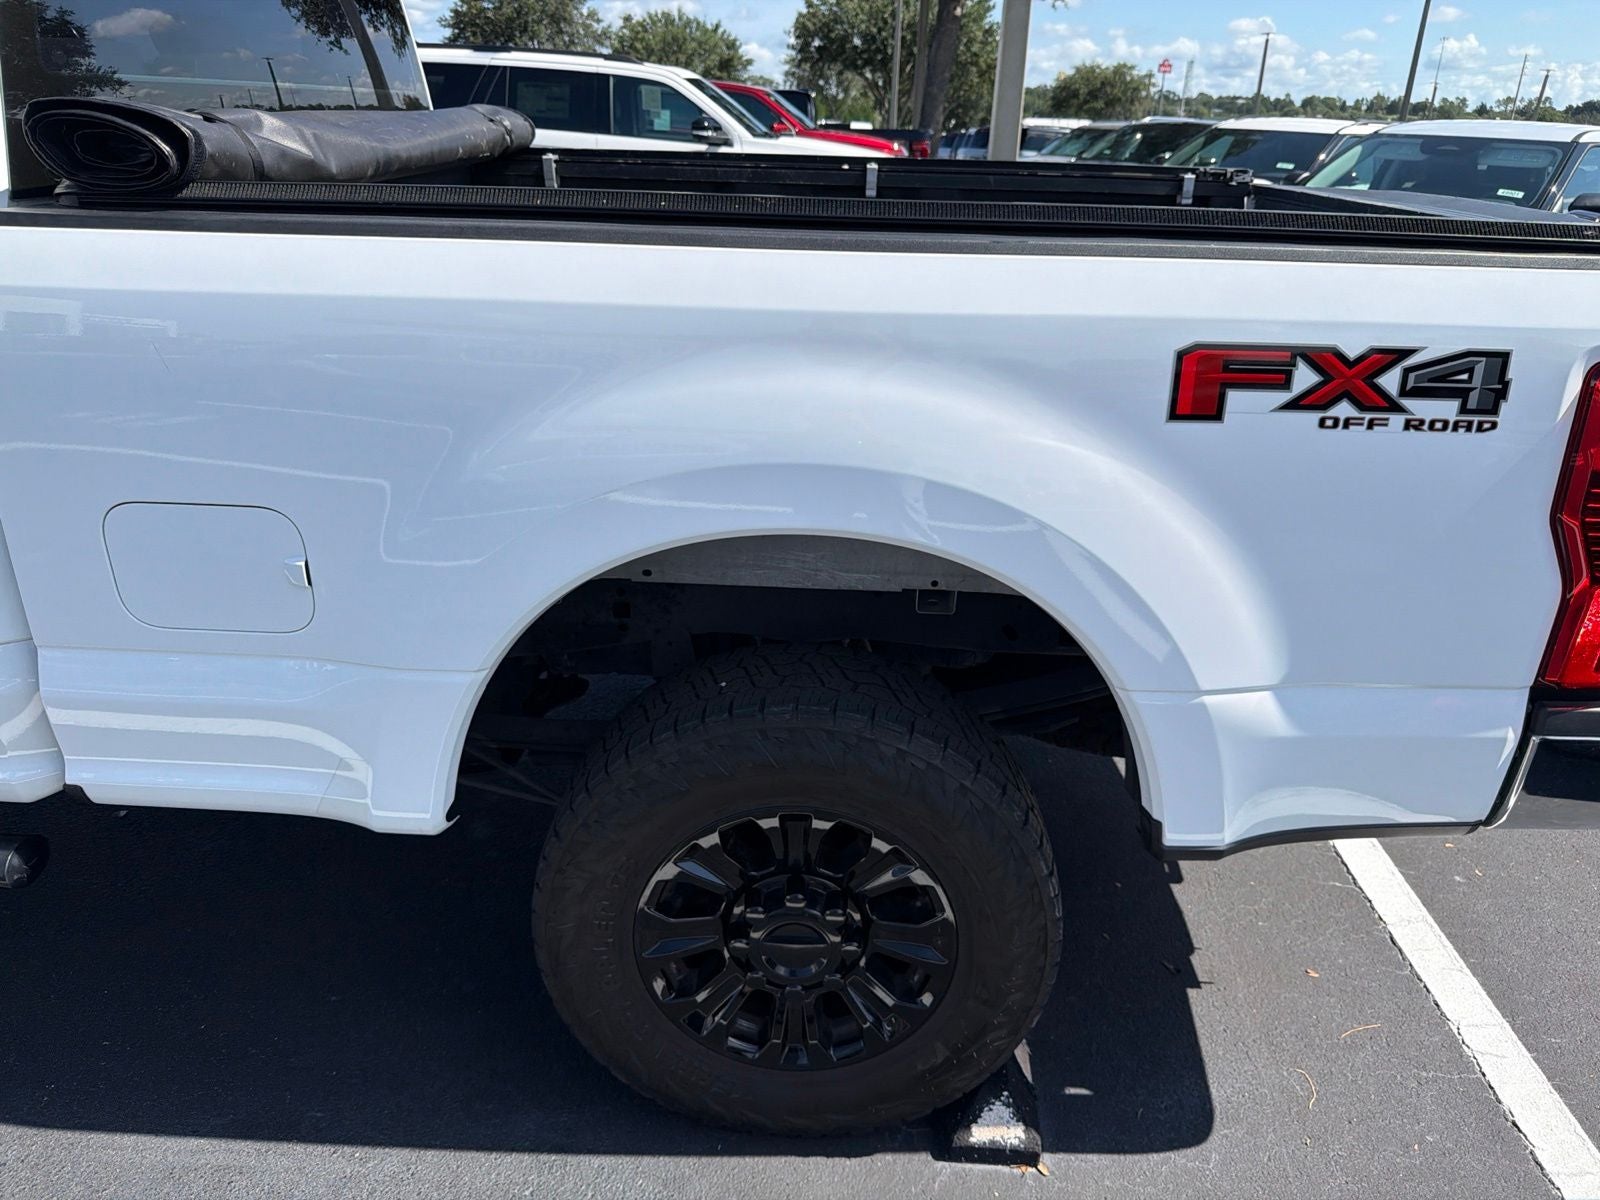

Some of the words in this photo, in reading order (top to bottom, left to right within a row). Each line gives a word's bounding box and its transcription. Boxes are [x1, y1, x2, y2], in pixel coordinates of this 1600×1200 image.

[1166, 341, 1513, 422] FX4
[1317, 415, 1390, 432] OFF
[1402, 417, 1499, 433] ROAD
